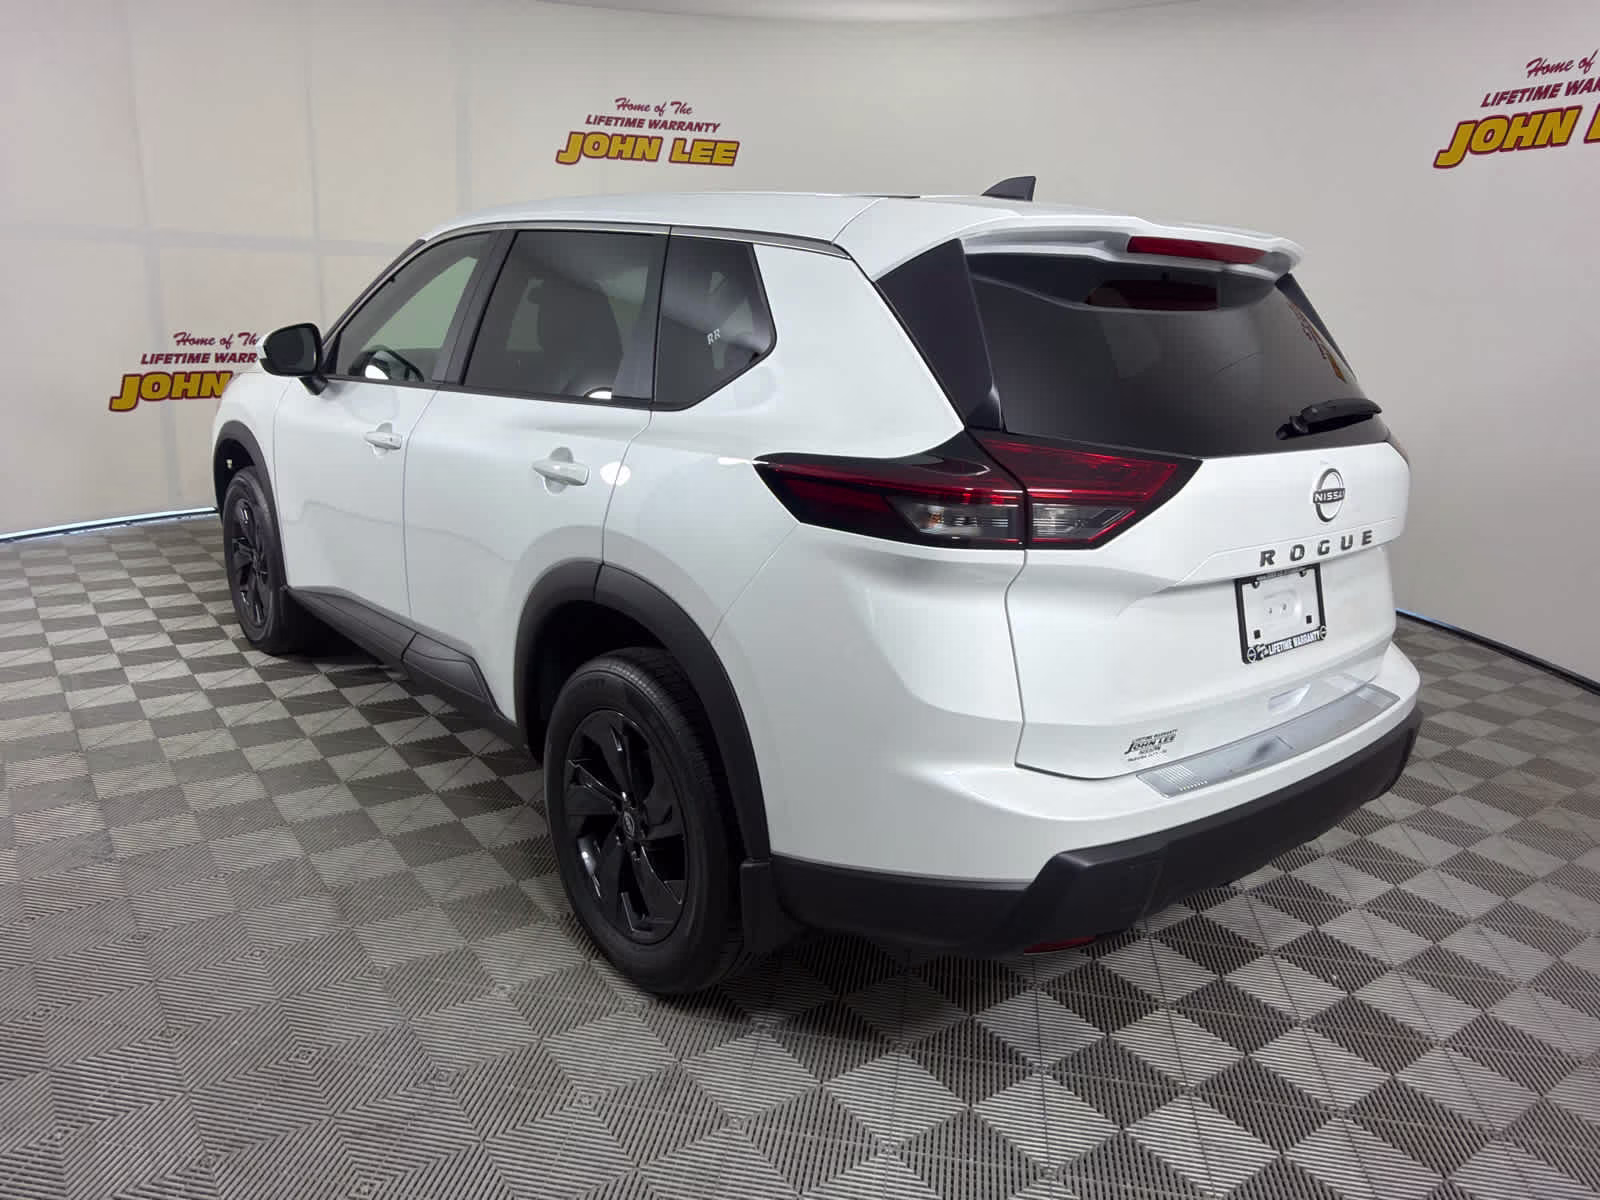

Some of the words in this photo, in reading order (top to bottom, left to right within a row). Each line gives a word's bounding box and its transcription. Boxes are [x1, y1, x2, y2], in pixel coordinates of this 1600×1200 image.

[1526, 57, 1574, 78] Home
[1578, 49, 1598, 75] of
[614, 97, 650, 112] Home
[654, 102, 667, 116] of
[670, 100, 693, 115] The
[1480, 83, 1563, 108] LIFETIME
[585, 114, 645, 129] LIFETIME
[648, 118, 720, 133] WARRANTY
[1433, 105, 1583, 169] JOHN
[555, 131, 663, 165] JOHN
[669, 137, 740, 166] LEE
[173, 331, 216, 346] Home
[219, 333, 234, 349] of
[237, 332, 257, 345] Th
[140, 353, 210, 364] LIFETIME
[214, 352, 258, 363] WARR
[109, 371, 233, 412] JOHN
[1259, 530, 1373, 567] ROGUE
